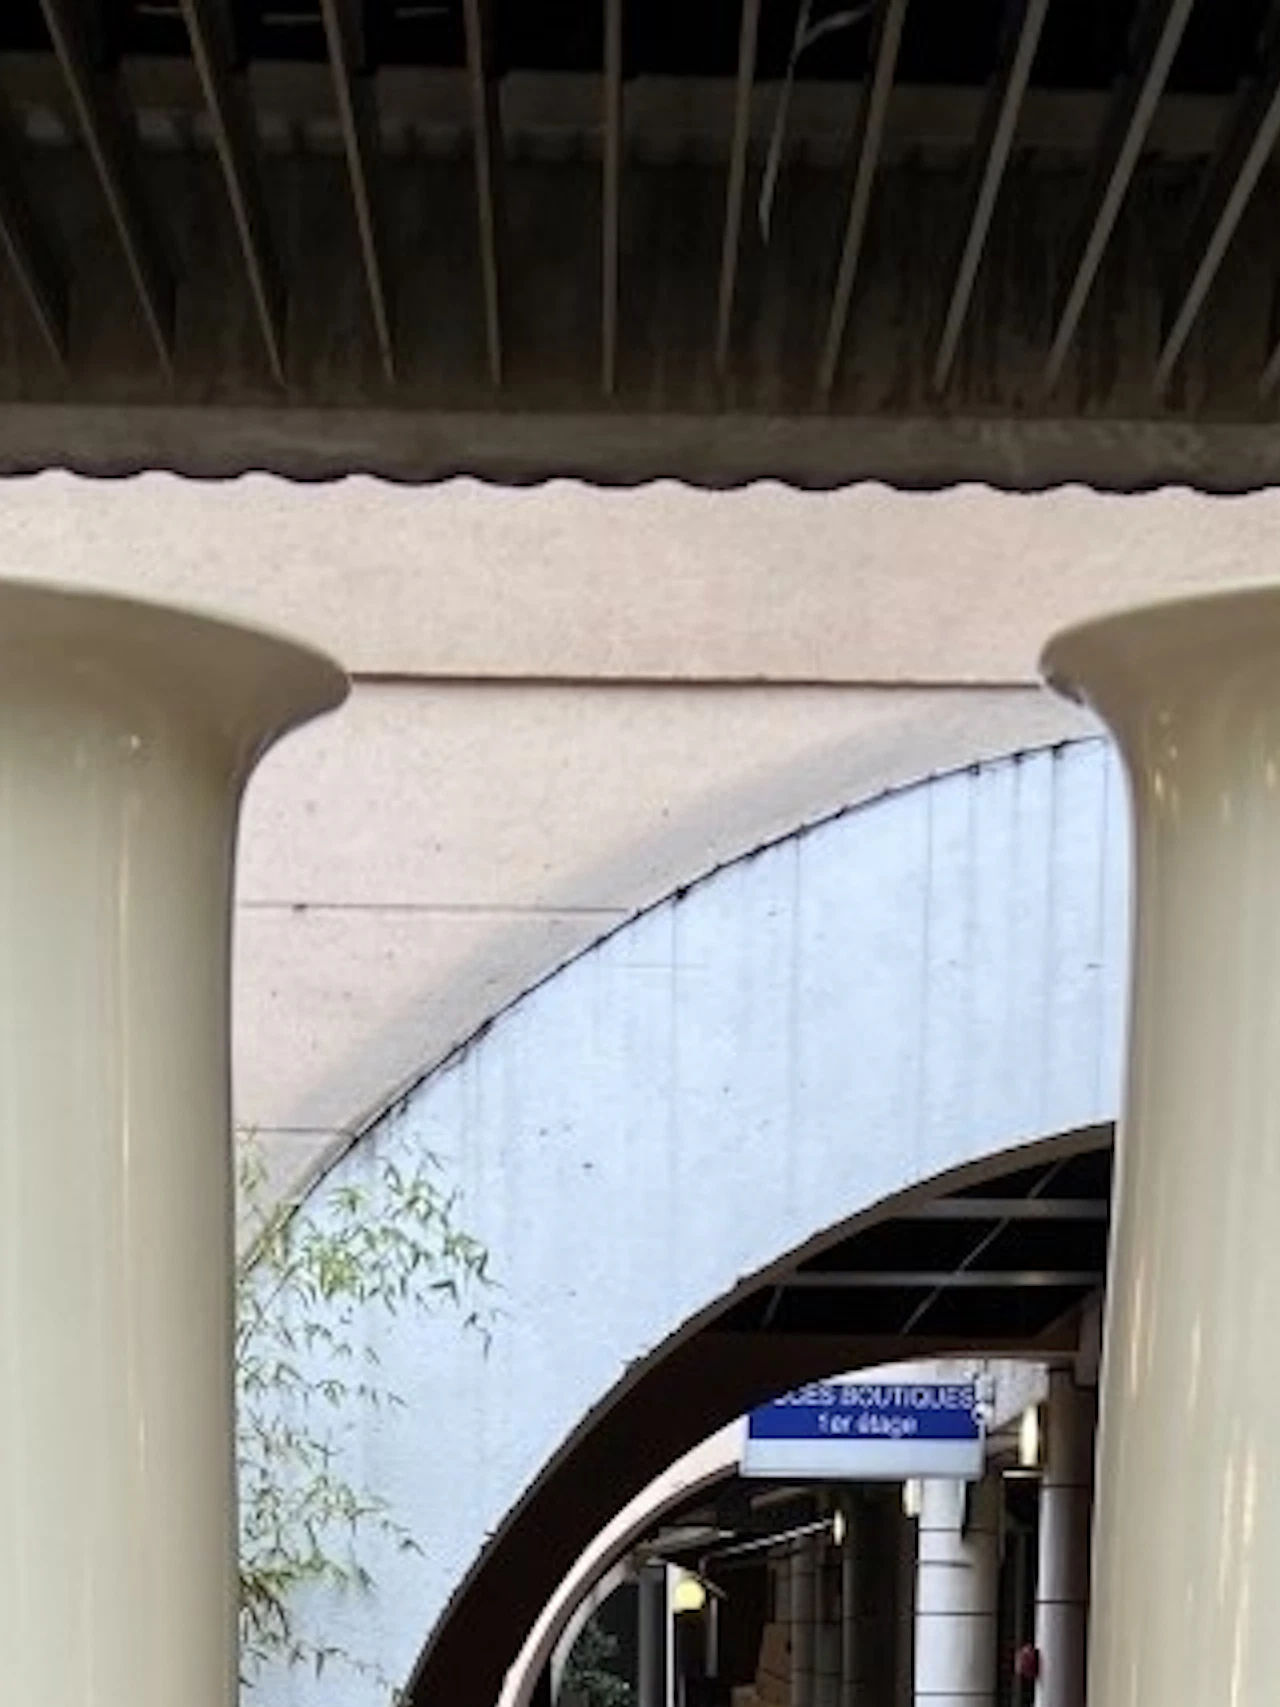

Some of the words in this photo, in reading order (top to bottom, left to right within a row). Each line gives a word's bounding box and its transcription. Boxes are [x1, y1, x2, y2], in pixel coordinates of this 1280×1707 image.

[840, 1386, 974, 1409] BOUTIQUES
[818, 1412, 852, 1433] 1er
[856, 1411, 917, 1438] étage
